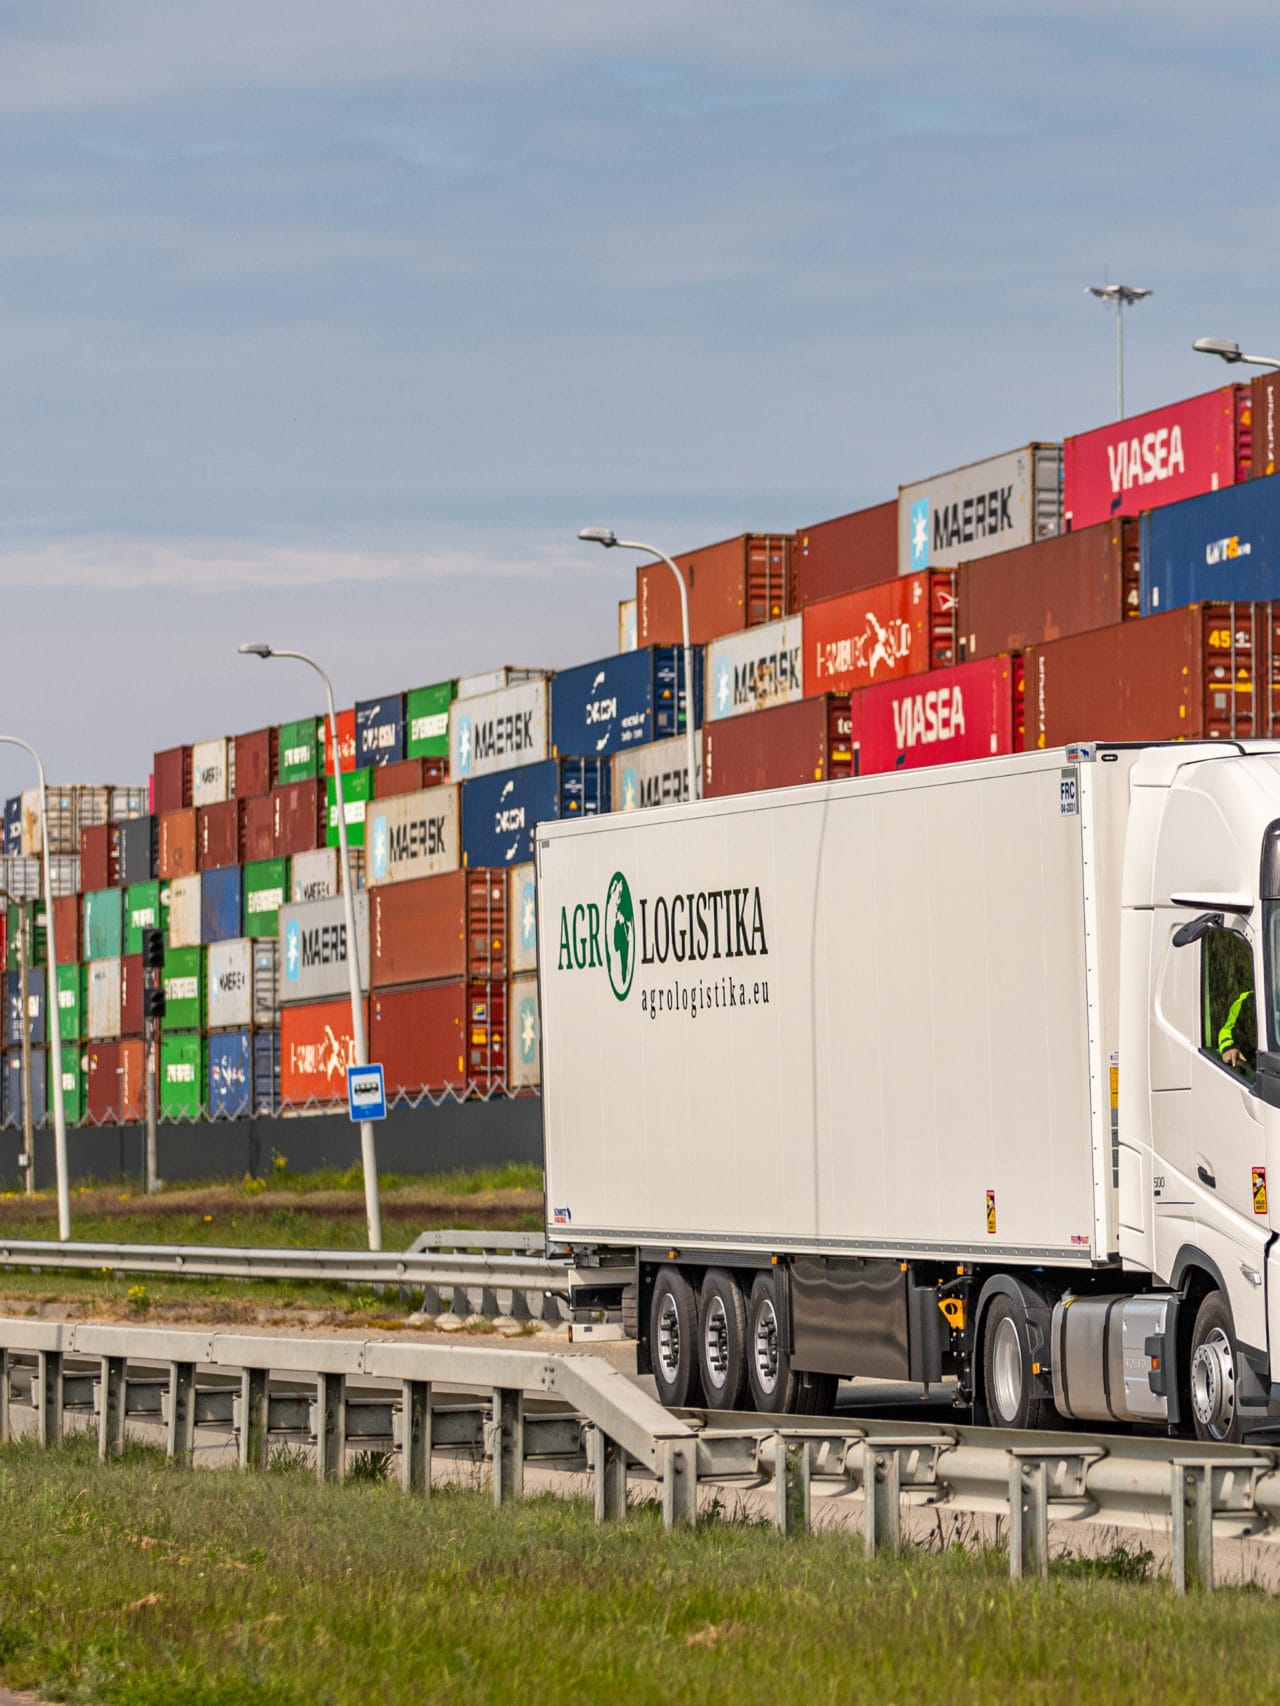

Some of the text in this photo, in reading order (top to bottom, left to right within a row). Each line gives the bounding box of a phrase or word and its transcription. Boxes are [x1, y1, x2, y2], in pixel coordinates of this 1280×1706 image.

[1108, 425, 1184, 492] VIASEA
[933, 484, 1014, 552] MAERSK
[1209, 629, 1231, 648] 45
[734, 647, 801, 705] MAERSK
[475, 711, 533, 759] MAERSK
[892, 685, 965, 749] VIASEA
[1061, 782, 1075, 800] FRC
[389, 815, 445, 862] MAERSK
[639, 886, 769, 965] LOGISTIKA
[641, 977, 770, 1020] agrologistika.eu
